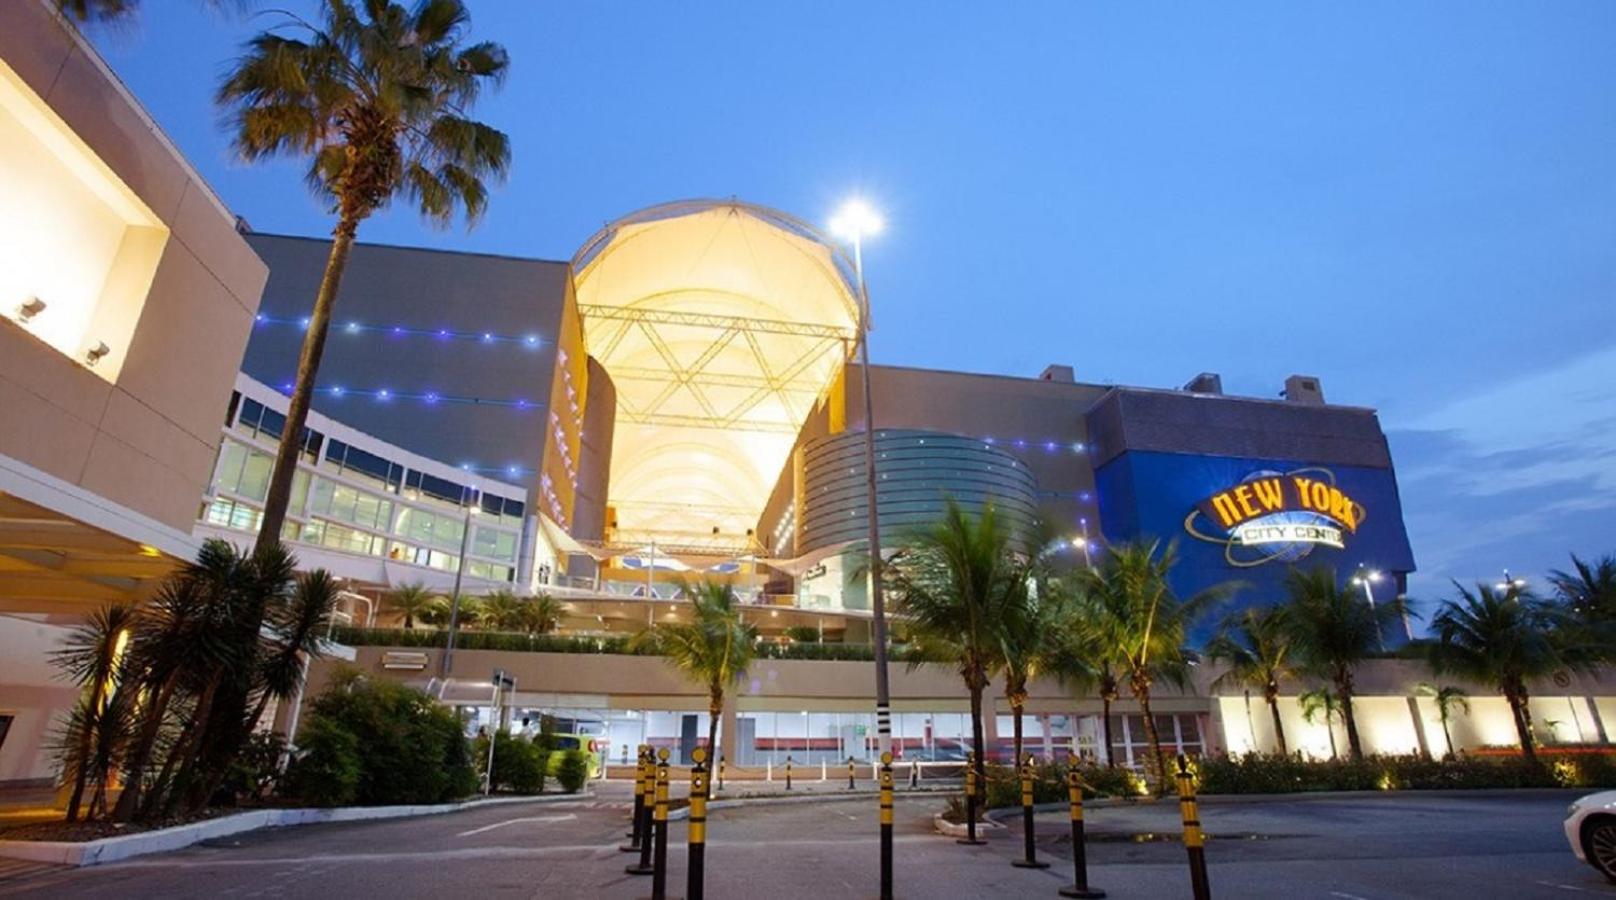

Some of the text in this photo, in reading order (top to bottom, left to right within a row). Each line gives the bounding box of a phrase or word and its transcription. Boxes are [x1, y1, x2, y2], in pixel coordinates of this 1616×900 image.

[1212, 477, 1356, 533] NEW YORK
[1243, 526, 1287, 540] CITY
